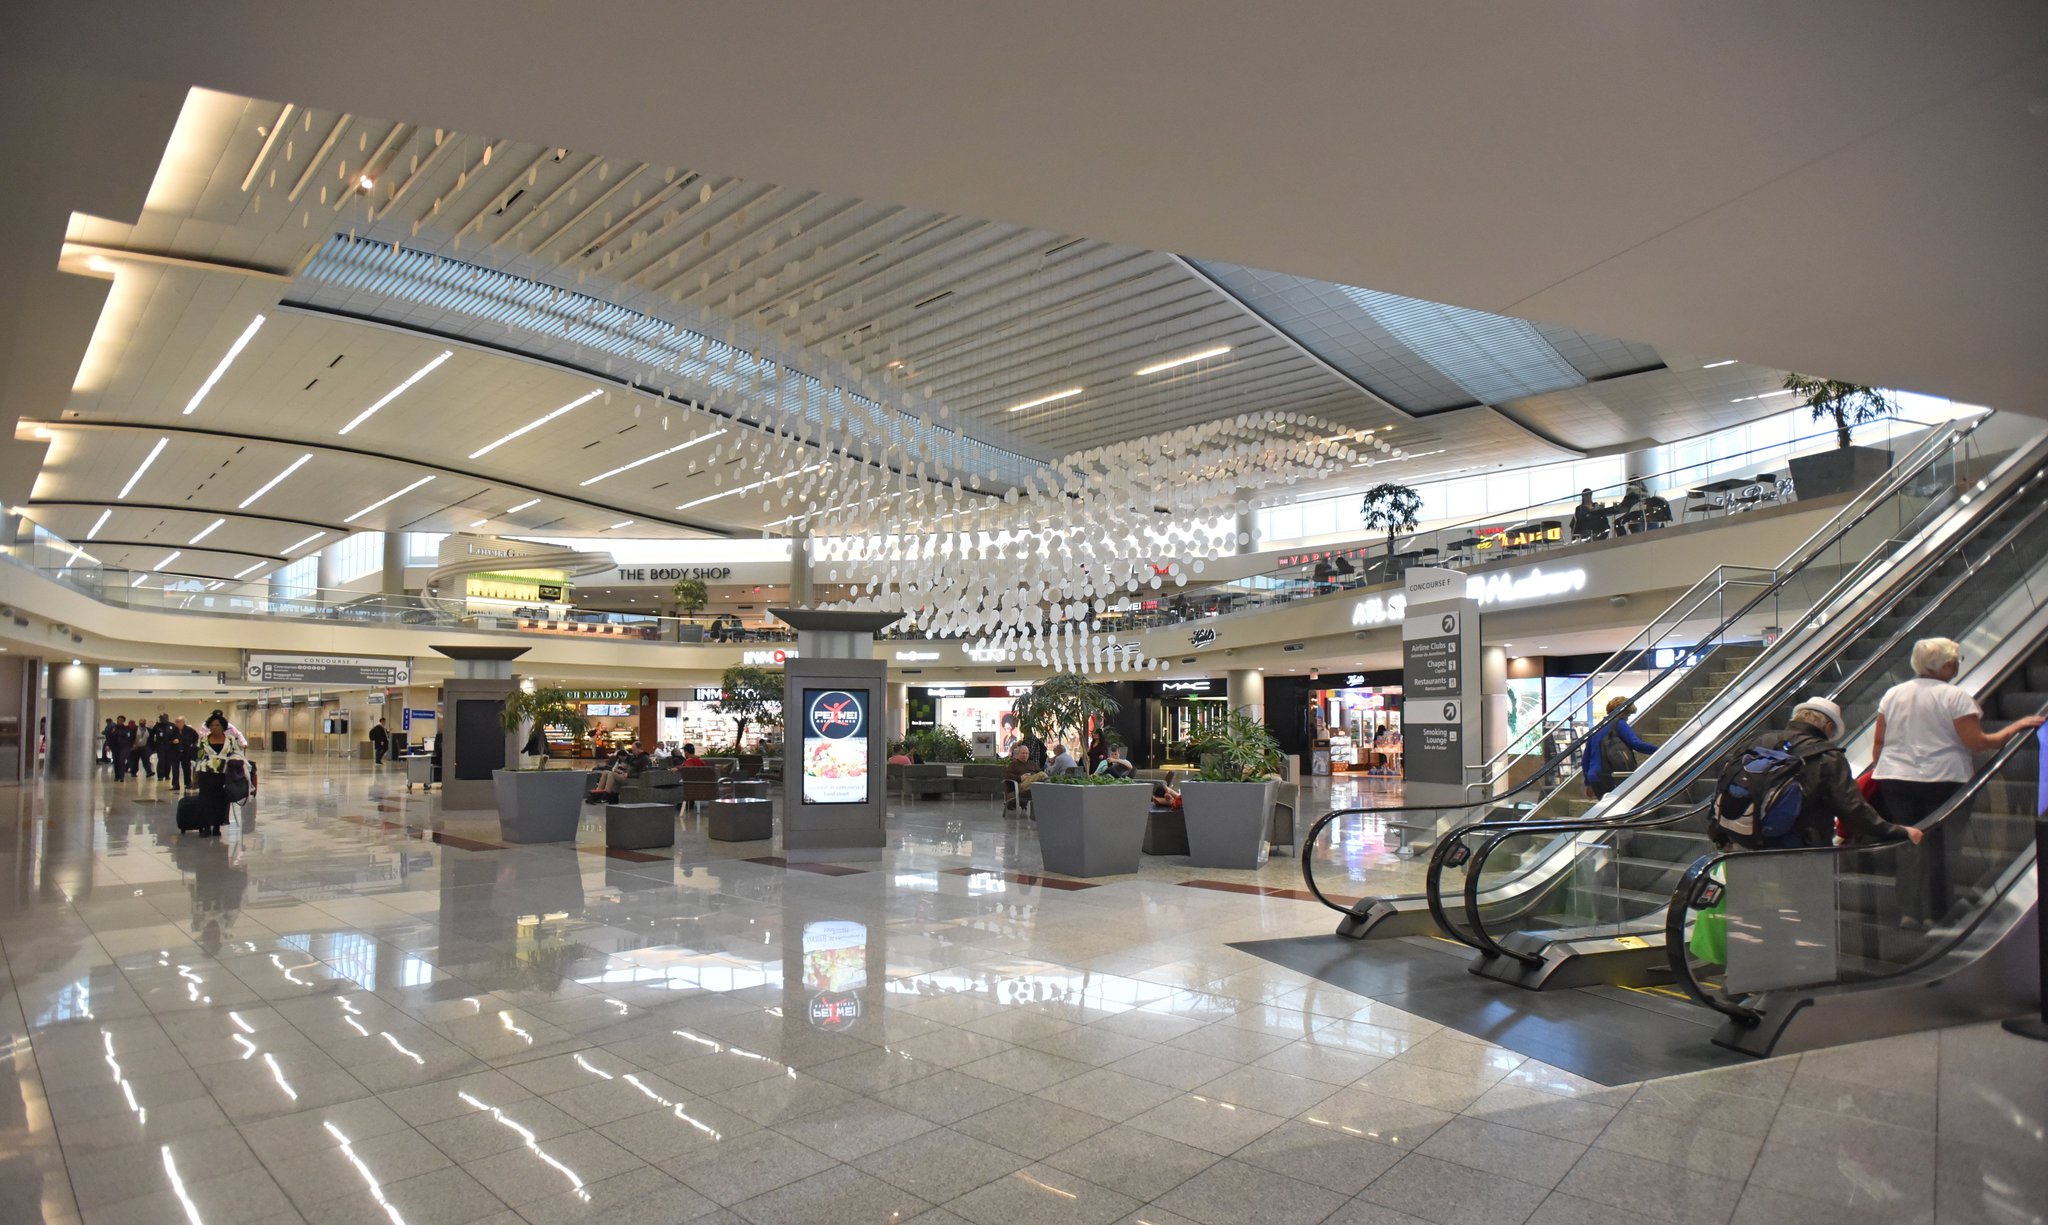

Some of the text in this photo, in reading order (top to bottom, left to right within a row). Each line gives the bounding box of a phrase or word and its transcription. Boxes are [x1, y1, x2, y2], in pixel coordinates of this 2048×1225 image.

[618, 567, 731, 581] THE BODY SHOP
[1409, 578, 1451, 592] CONCOURSE F
[1411, 642, 1446, 652] Airline Clubs
[304, 657, 350, 665] CONCOURSE
[1427, 659, 1447, 668] Chapel
[584, 691, 628, 699] MEADOW
[814, 711, 858, 720] PEI WEI
[1423, 728, 1447, 737] Smoking
[1426, 736, 1447, 745] Lounge
